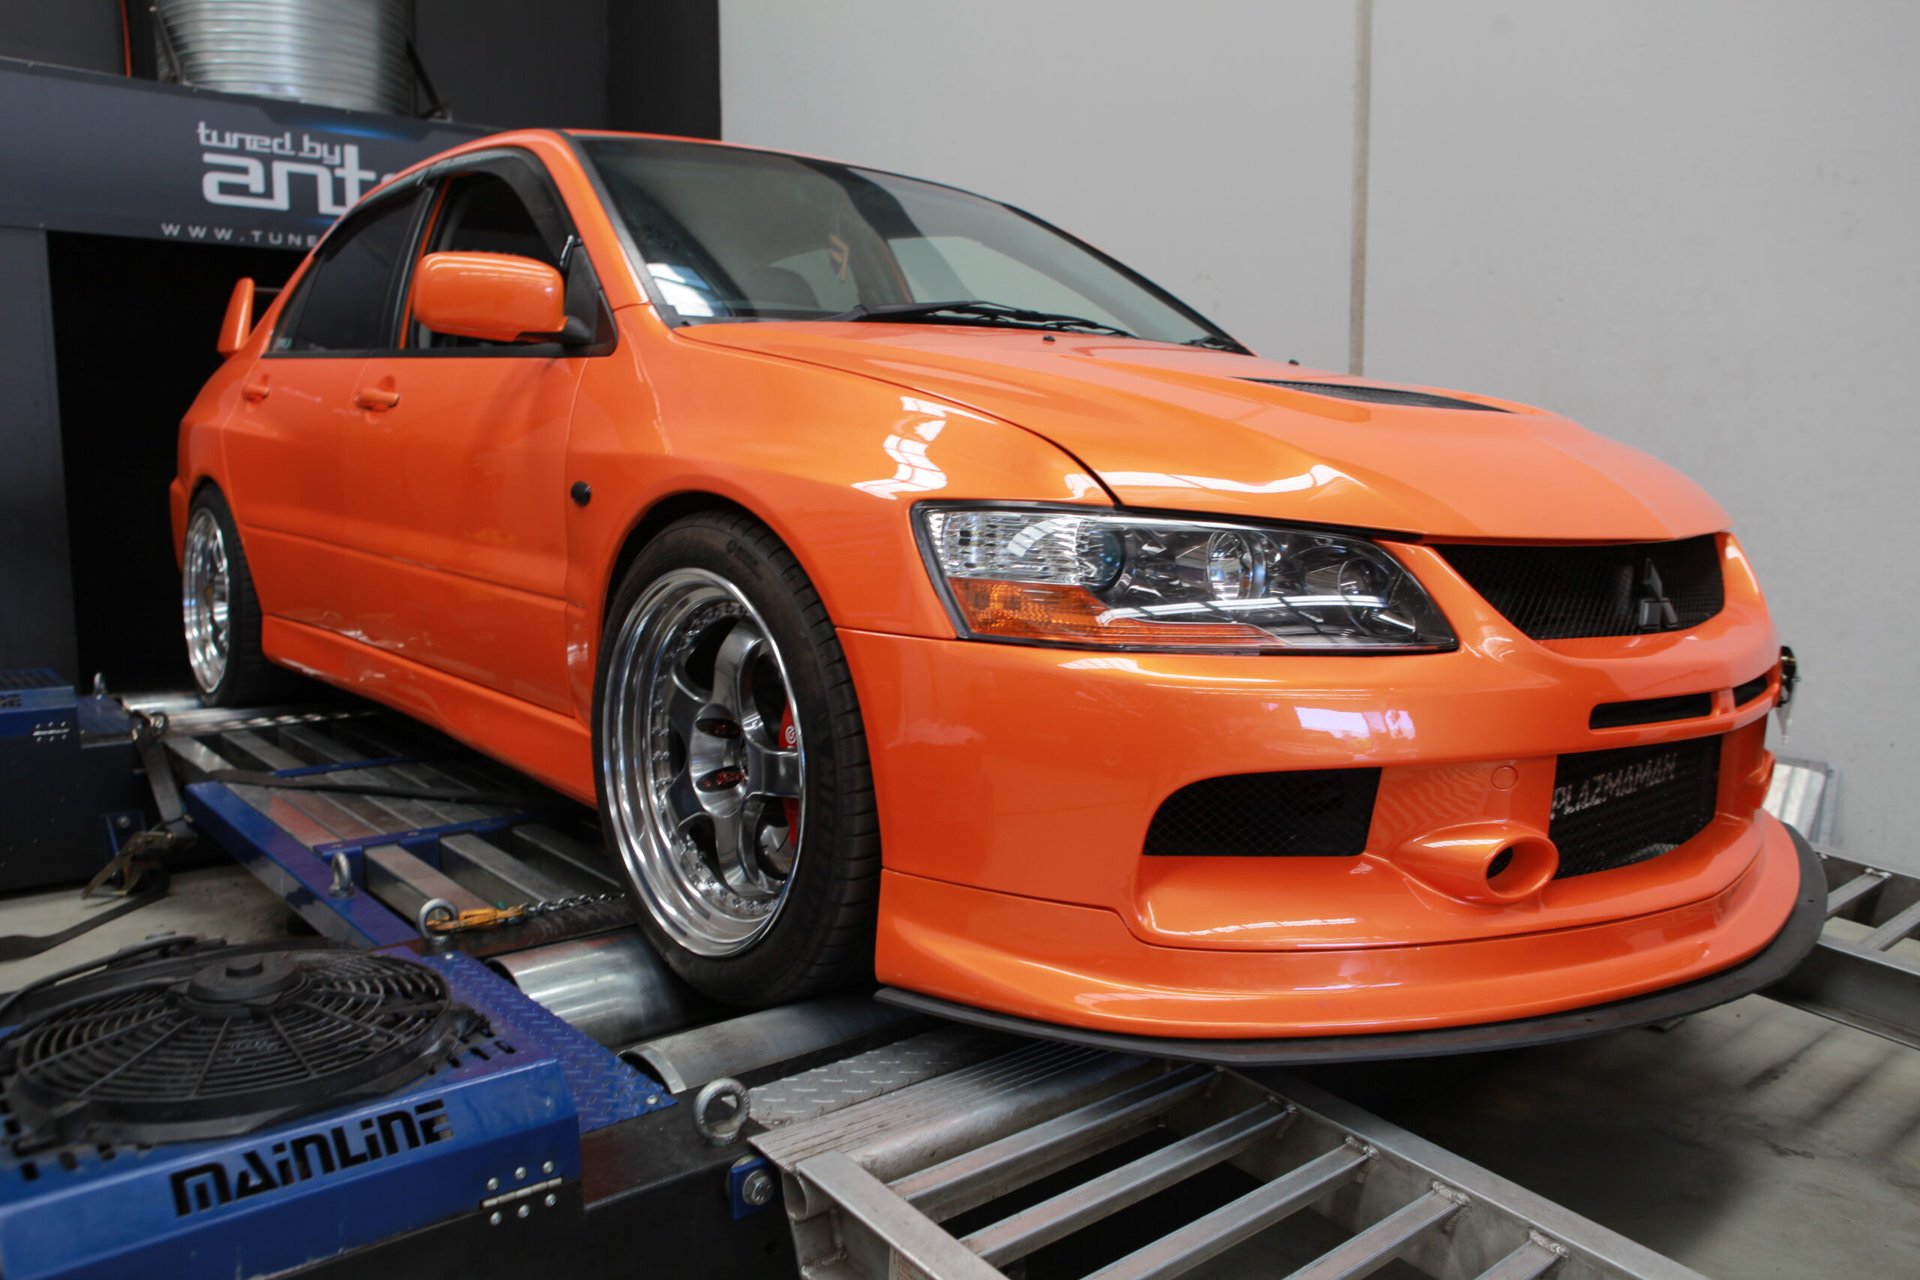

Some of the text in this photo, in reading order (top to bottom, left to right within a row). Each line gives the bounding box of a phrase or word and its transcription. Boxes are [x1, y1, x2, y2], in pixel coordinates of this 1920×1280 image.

[196, 120, 342, 166] tuned by
[202, 143, 397, 216] ant
